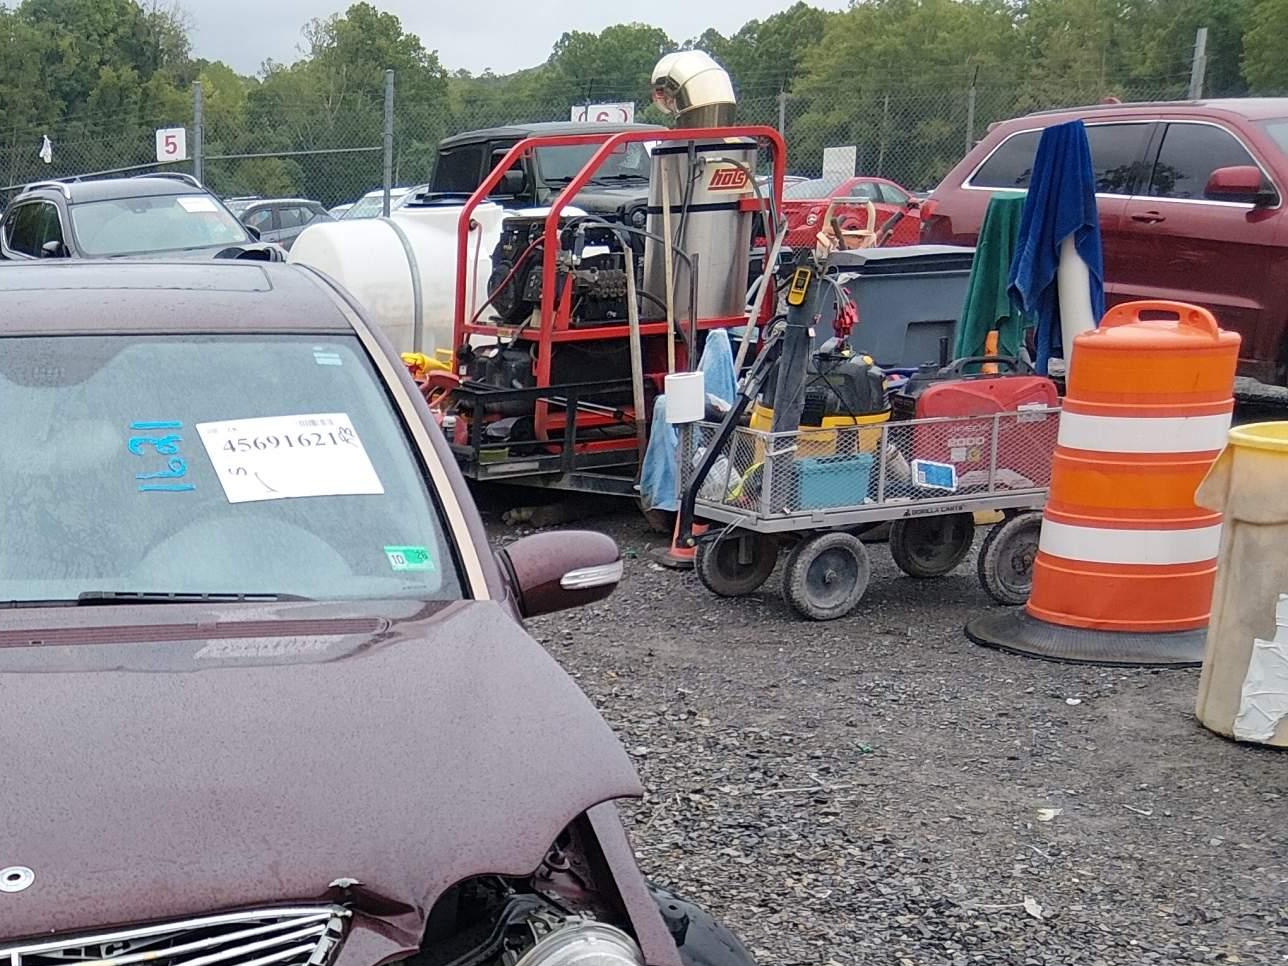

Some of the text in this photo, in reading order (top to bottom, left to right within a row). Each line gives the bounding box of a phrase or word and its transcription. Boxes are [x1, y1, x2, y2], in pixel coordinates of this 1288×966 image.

[165, 135, 177, 155] 5
[223, 432, 338, 453] 45691621
[128, 420, 196, 491] 1621
[392, 554, 404, 565] 10
